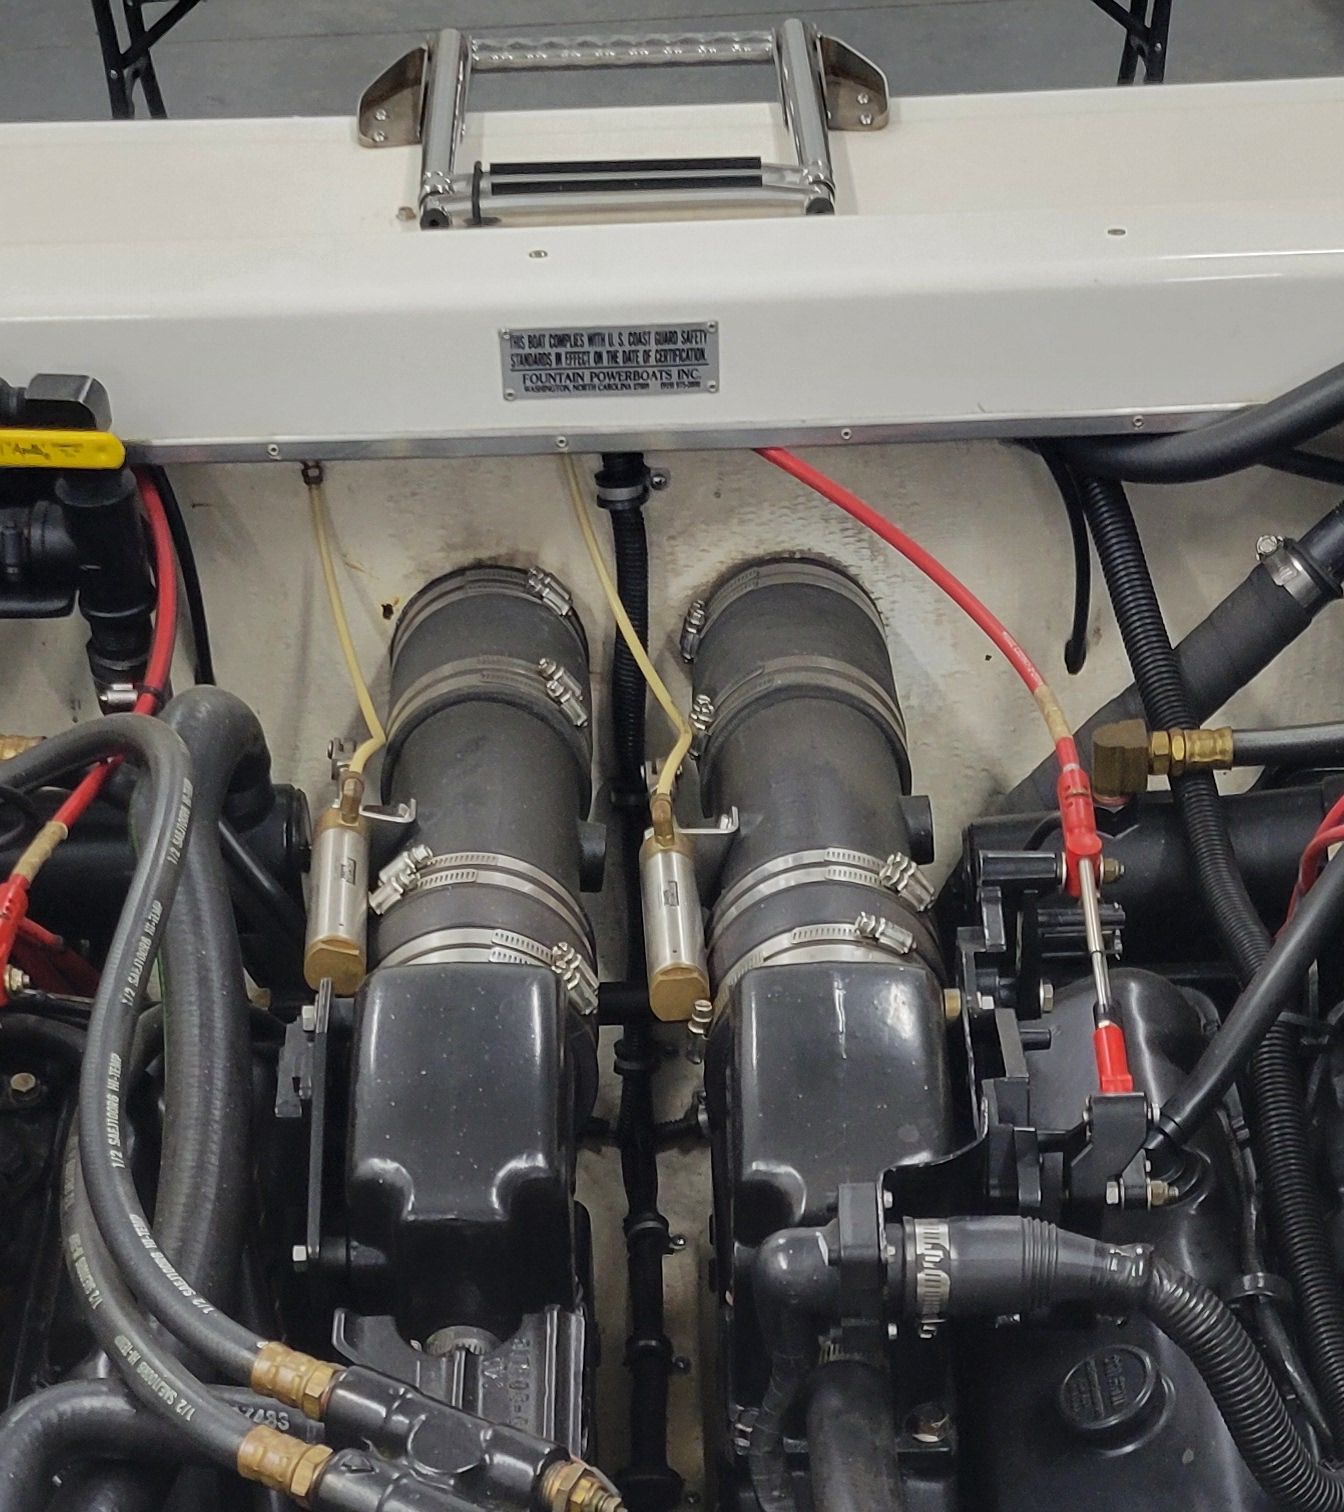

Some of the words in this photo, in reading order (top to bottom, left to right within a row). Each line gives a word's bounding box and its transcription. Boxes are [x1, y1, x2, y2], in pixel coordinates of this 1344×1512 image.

[528, 334, 545, 350] BOAT
[549, 333, 584, 349] COMPLIES
[587, 332, 605, 348] WITH
[618, 332, 625, 347] S.
[628, 330, 651, 346] COAST
[655, 329, 678, 345] GUARD
[681, 329, 708, 345] SAFETY
[510, 352, 552, 368] STANDARDS
[555, 351, 562, 366] IN
[565, 351, 590, 366] EFFECT
[594, 351, 603, 365] ON
[606, 350, 619, 365] THE
[623, 349, 639, 364] DATE
[643, 349, 652, 364] OF
[522, 371, 585, 385] FOUNTAIN
[590, 369, 672, 383] POWERBOATS
[678, 368, 702, 380] INC.
[573, 383, 597, 392] NORTH
[121, 987, 136, 1006] 1/2
[106, 1051, 123, 1092] HI-TEMP
[111, 1149, 125, 1168] 1/2
[128, 1212, 157, 1249] HI-TEMP
[193, 1292, 216, 1315] 1/2
[175, 1395, 196, 1422] 1/2
